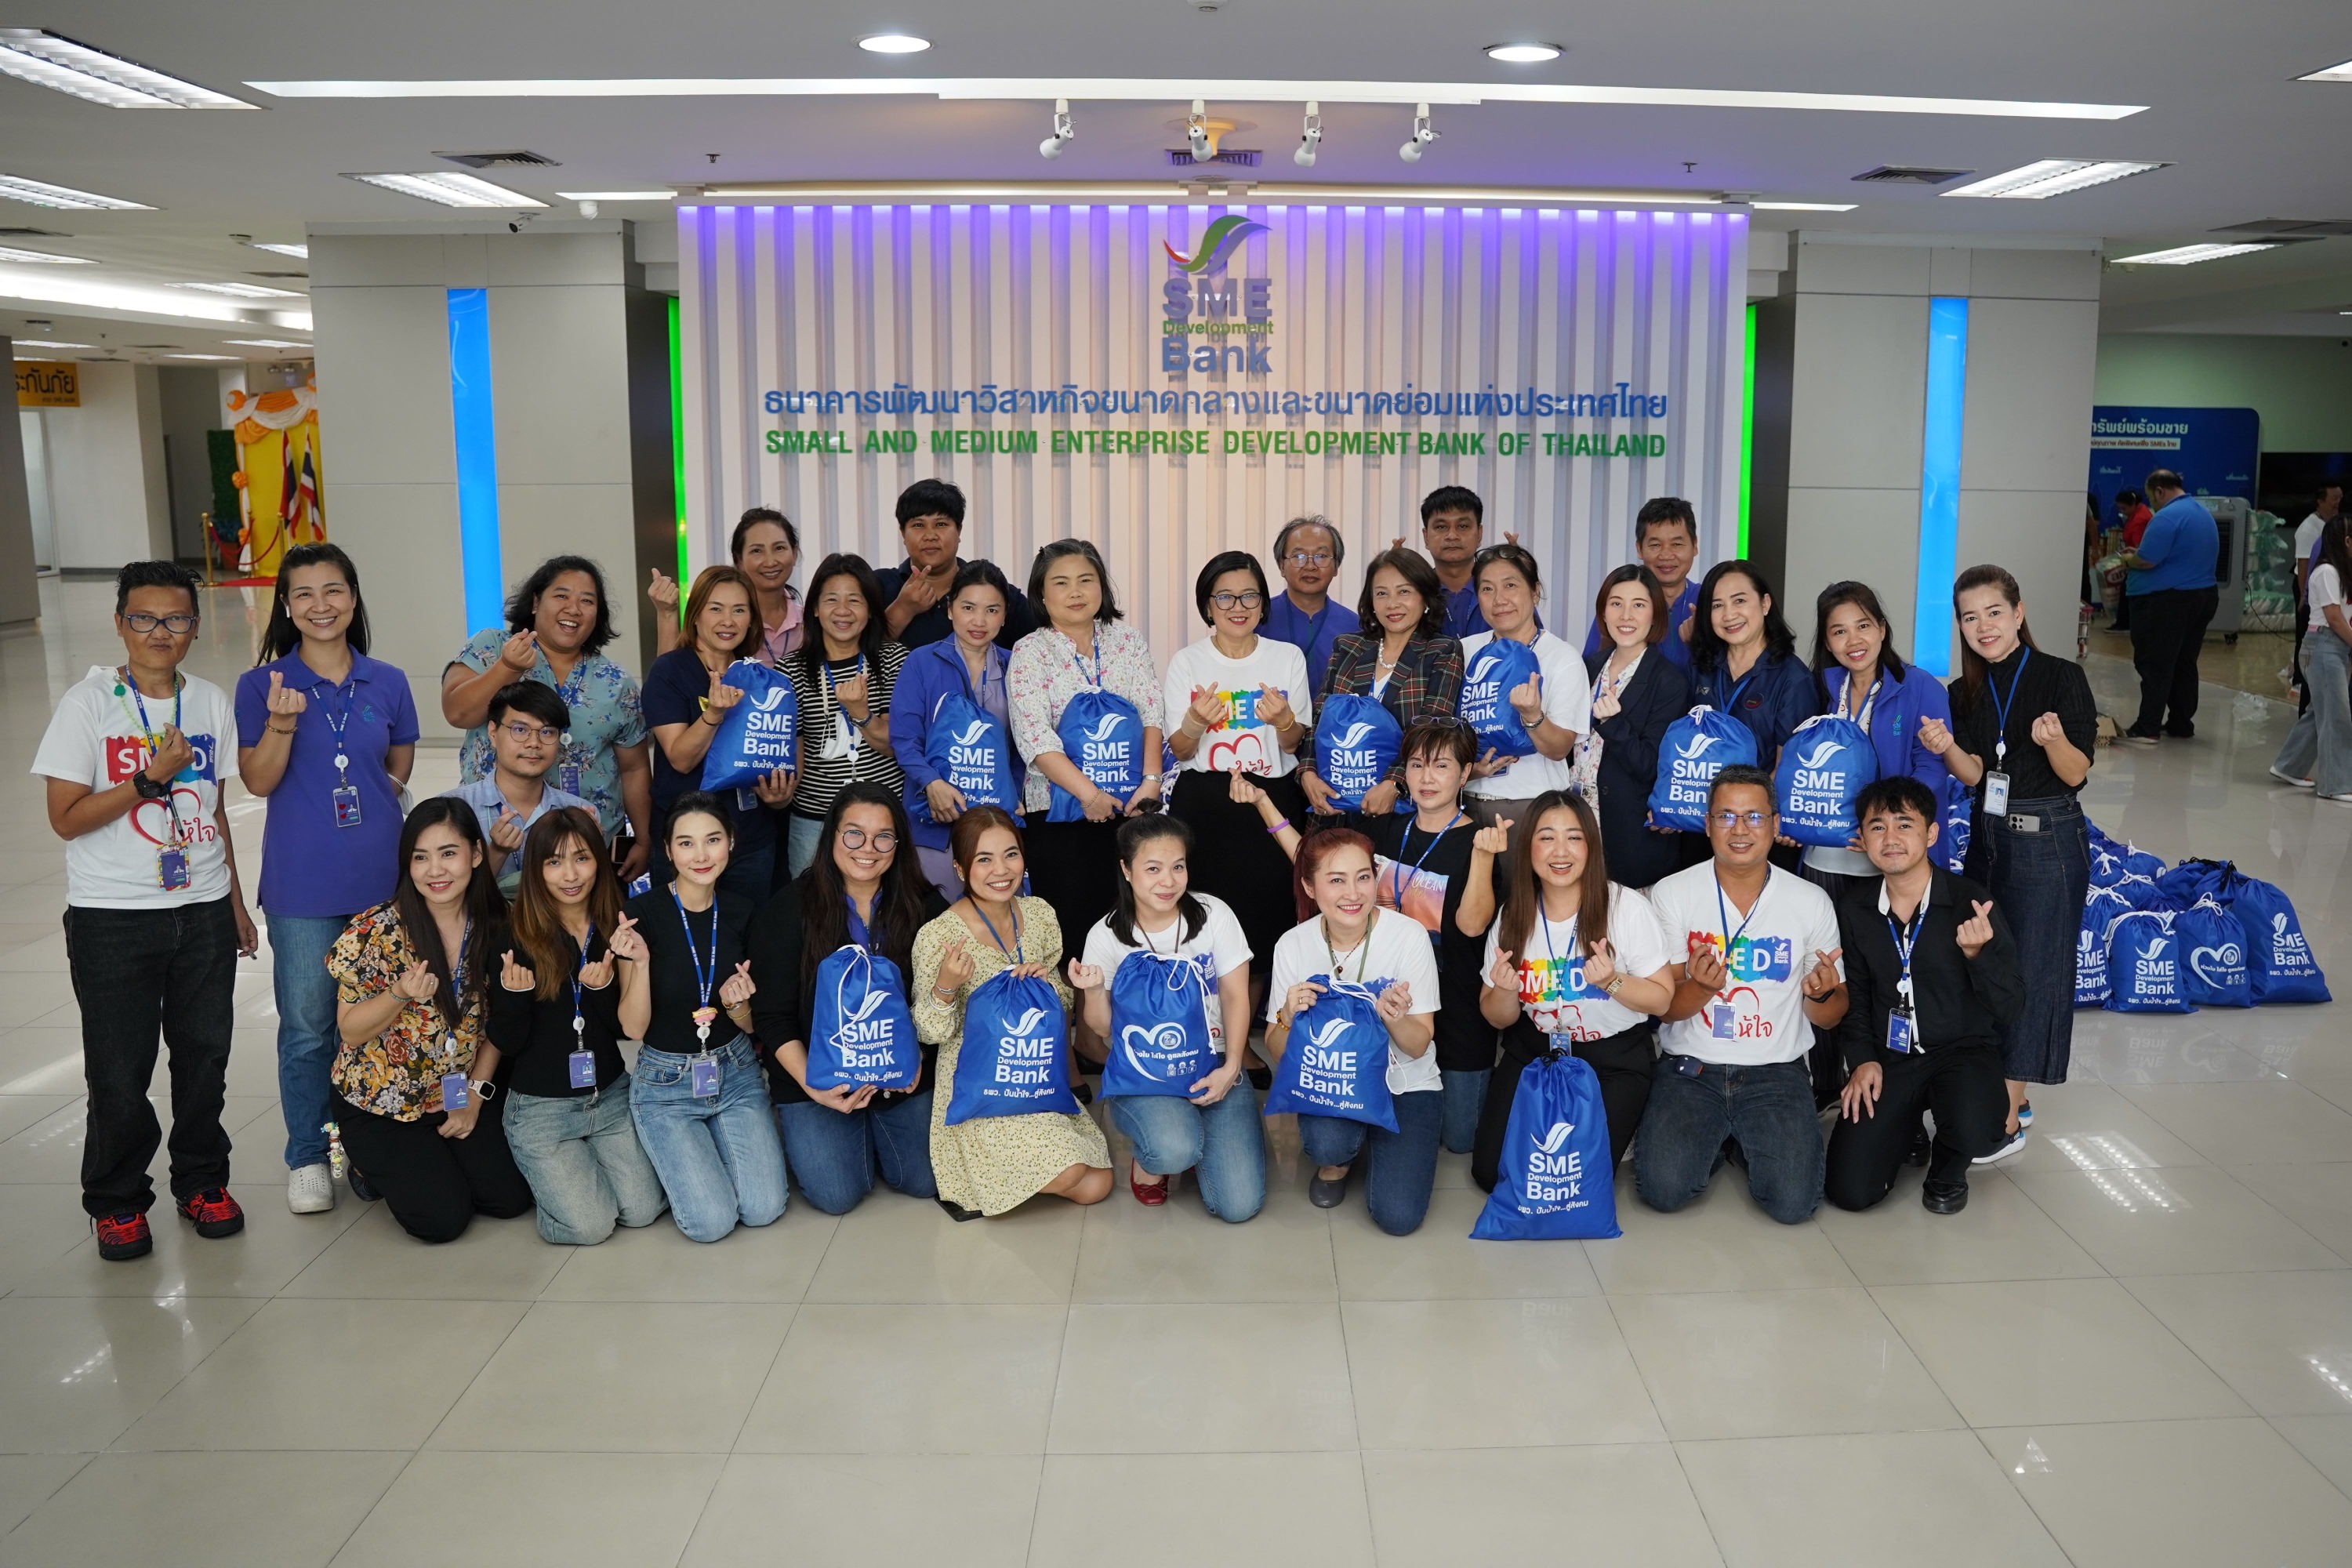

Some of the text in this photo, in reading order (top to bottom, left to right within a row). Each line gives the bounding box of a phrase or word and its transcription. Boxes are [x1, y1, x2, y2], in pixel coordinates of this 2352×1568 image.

[1162, 278, 1272, 318] SME
[1163, 320, 1274, 334] Development
[1162, 337, 1273, 372] Bank
[764, 382, 1668, 418] ธนาคารพัฒนาวิสาหกิจขนาดกลางและขนาดย่อมแห่งประเทศไทย
[766, 430, 1666, 458] SMALL AND MEDIUM ENTERPRISE DEVELOPMENT BANK OF THAILAND
[1461, 682, 1501, 702] SME
[1461, 696, 1497, 710] Development
[746, 711, 793, 732] SME
[745, 730, 791, 740] Development
[743, 738, 790, 757] Bank
[948, 746, 995, 766] SME
[1083, 741, 1130, 760] SME
[1330, 749, 1377, 768] SME
[1082, 766, 1130, 782] Bank
[1330, 765, 1377, 775] Development
[1672, 759, 1722, 780] SME
[949, 771, 994, 790] Bank
[1330, 772, 1377, 789] Bank
[1671, 777, 1711, 788] Developm
[1793, 769, 1846, 790] SME
[1669, 785, 1707, 804] Ban
[1791, 787, 1844, 799] Development
[1790, 795, 1842, 815] Bank
[1412, 872, 1444, 892] OCEAN
[2273, 932, 2305, 947] SME
[1711, 944, 1771, 971] ME D
[2077, 949, 2105, 967] SME
[2274, 952, 2310, 965] Bank
[2077, 964, 2106, 975] evelopment
[2136, 960, 2175, 975] SME
[1570, 967, 1588, 992] D
[2075, 972, 2107, 989] Bank
[2136, 974, 2175, 982] Development
[2135, 981, 2175, 995] Bank
[843, 1018, 894, 1043] SME
[1567, 1025, 1601, 1042] ห้ใจ
[1735, 1014, 1773, 1037] ห้ใจ
[844, 1038, 893, 1051] Development
[999, 1036, 1054, 1058] SME
[842, 1047, 895, 1068] Bank
[997, 1056, 1052, 1067] Development
[1302, 1045, 1357, 1072] SME
[995, 1064, 1051, 1084] Bank
[1301, 1063, 1357, 1080] Development
[1299, 1071, 1355, 1096] Bank
[1529, 1151, 1582, 1175] SME
[1527, 1171, 1582, 1185] Development
[1526, 1181, 1581, 1201] Bank
